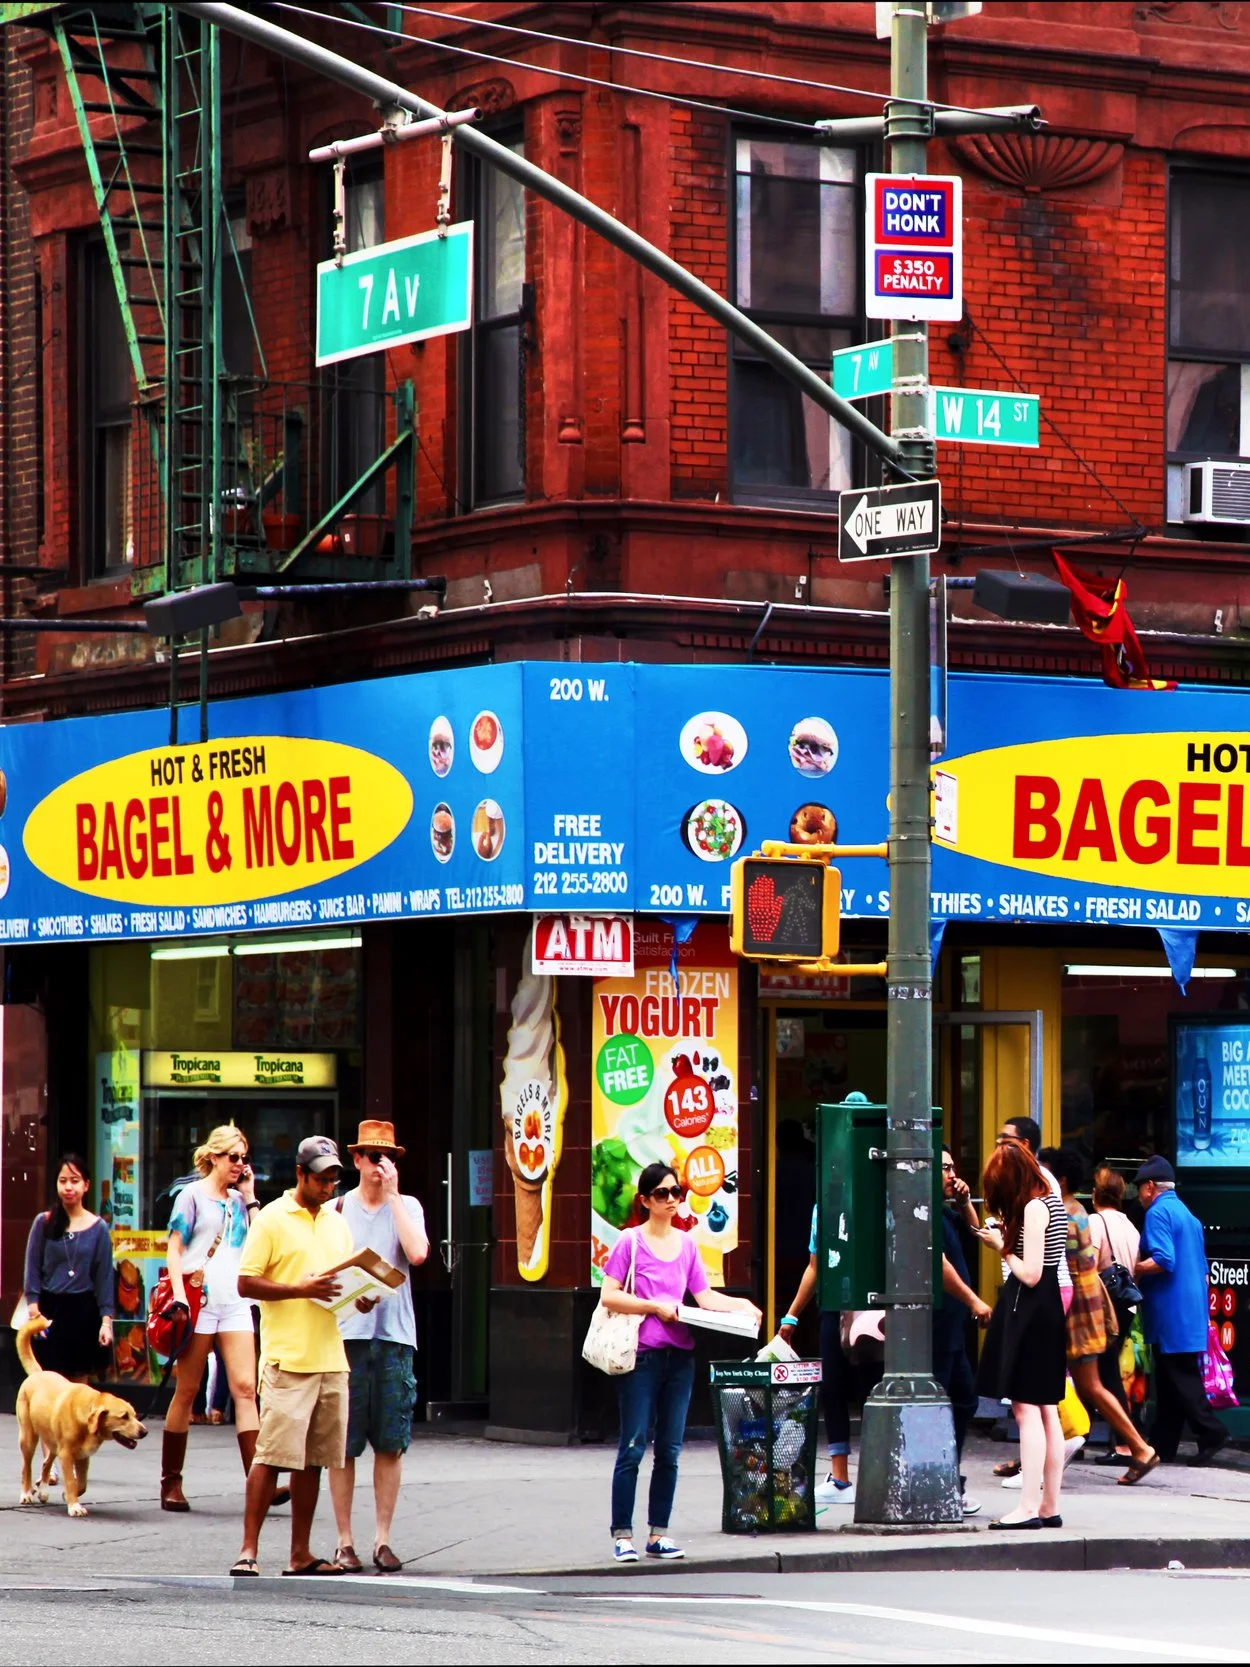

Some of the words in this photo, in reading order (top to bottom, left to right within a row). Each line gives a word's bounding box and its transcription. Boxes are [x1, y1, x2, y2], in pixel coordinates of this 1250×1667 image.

[885, 193, 941, 212] DON'T
[886, 214, 940, 232] HONK
[893, 260, 934, 275] $350
[883, 275, 943, 290] PENALTY
[359, 274, 374, 331] 7
[851, 354, 862, 392] 7
[942, 396, 964, 434] W
[976, 399, 1001, 437] 14
[1013, 402, 1029, 422] ST
[855, 510, 882, 538] ONE
[896, 504, 926, 533] WAY
[550, 679, 583, 701] 200
[588, 679, 609, 701] W.
[150, 756, 186, 787] HOT
[191, 753, 204, 781] &
[209, 745, 266, 781] FRESH
[76, 795, 194, 882] BAGEL
[206, 790, 232, 873] &
[242, 775, 355, 869] MORE
[554, 815, 601, 837] FREE
[534, 842, 624, 865] DELIVERY
[534, 872, 557, 894] 212
[562, 871, 628, 894] 255-2800
[650, 884, 682, 906] 200
[687, 884, 707, 906] W.
[38, 915, 83, 937] SMOOTHIES
[91, 913, 122, 934] SHAKES
[131, 912, 157, 933] FRESH
[159, 909, 185, 931] SALAD
[192, 904, 247, 929] SANDWICHES
[254, 900, 312, 924] HAMBURGERS
[319, 895, 345, 918] JUICE
[346, 893, 365, 916] BAR
[373, 891, 402, 914] PANINI
[410, 888, 440, 911] WRAPS
[466, 886, 482, 908] 212
[483, 884, 523, 907] 255-2800
[878, 890, 981, 916] STHIES
[1000, 893, 1068, 918] SHAKES
[1085, 897, 1141, 920] FRESH
[1145, 898, 1200, 922] SALAD
[544, 917, 624, 961] ATM
[633, 931, 659, 944] Guilt
[645, 970, 730, 999] FROZEN
[599, 995, 719, 1038] YOGURT
[170, 1054, 221, 1074] Tropicana
[605, 1043, 639, 1069] FAT
[1222, 1041, 1243, 1062] BIG
[254, 1055, 303, 1074] Tropicana
[602, 1064, 650, 1094] FREE
[668, 1085, 708, 1116] 143
[688, 1155, 721, 1181] ALL
[1210, 1261, 1248, 1286] Street
[1209, 1293, 1217, 1311] 2
[1225, 1294, 1232, 1311] 3
[1223, 1327, 1231, 1345] M
